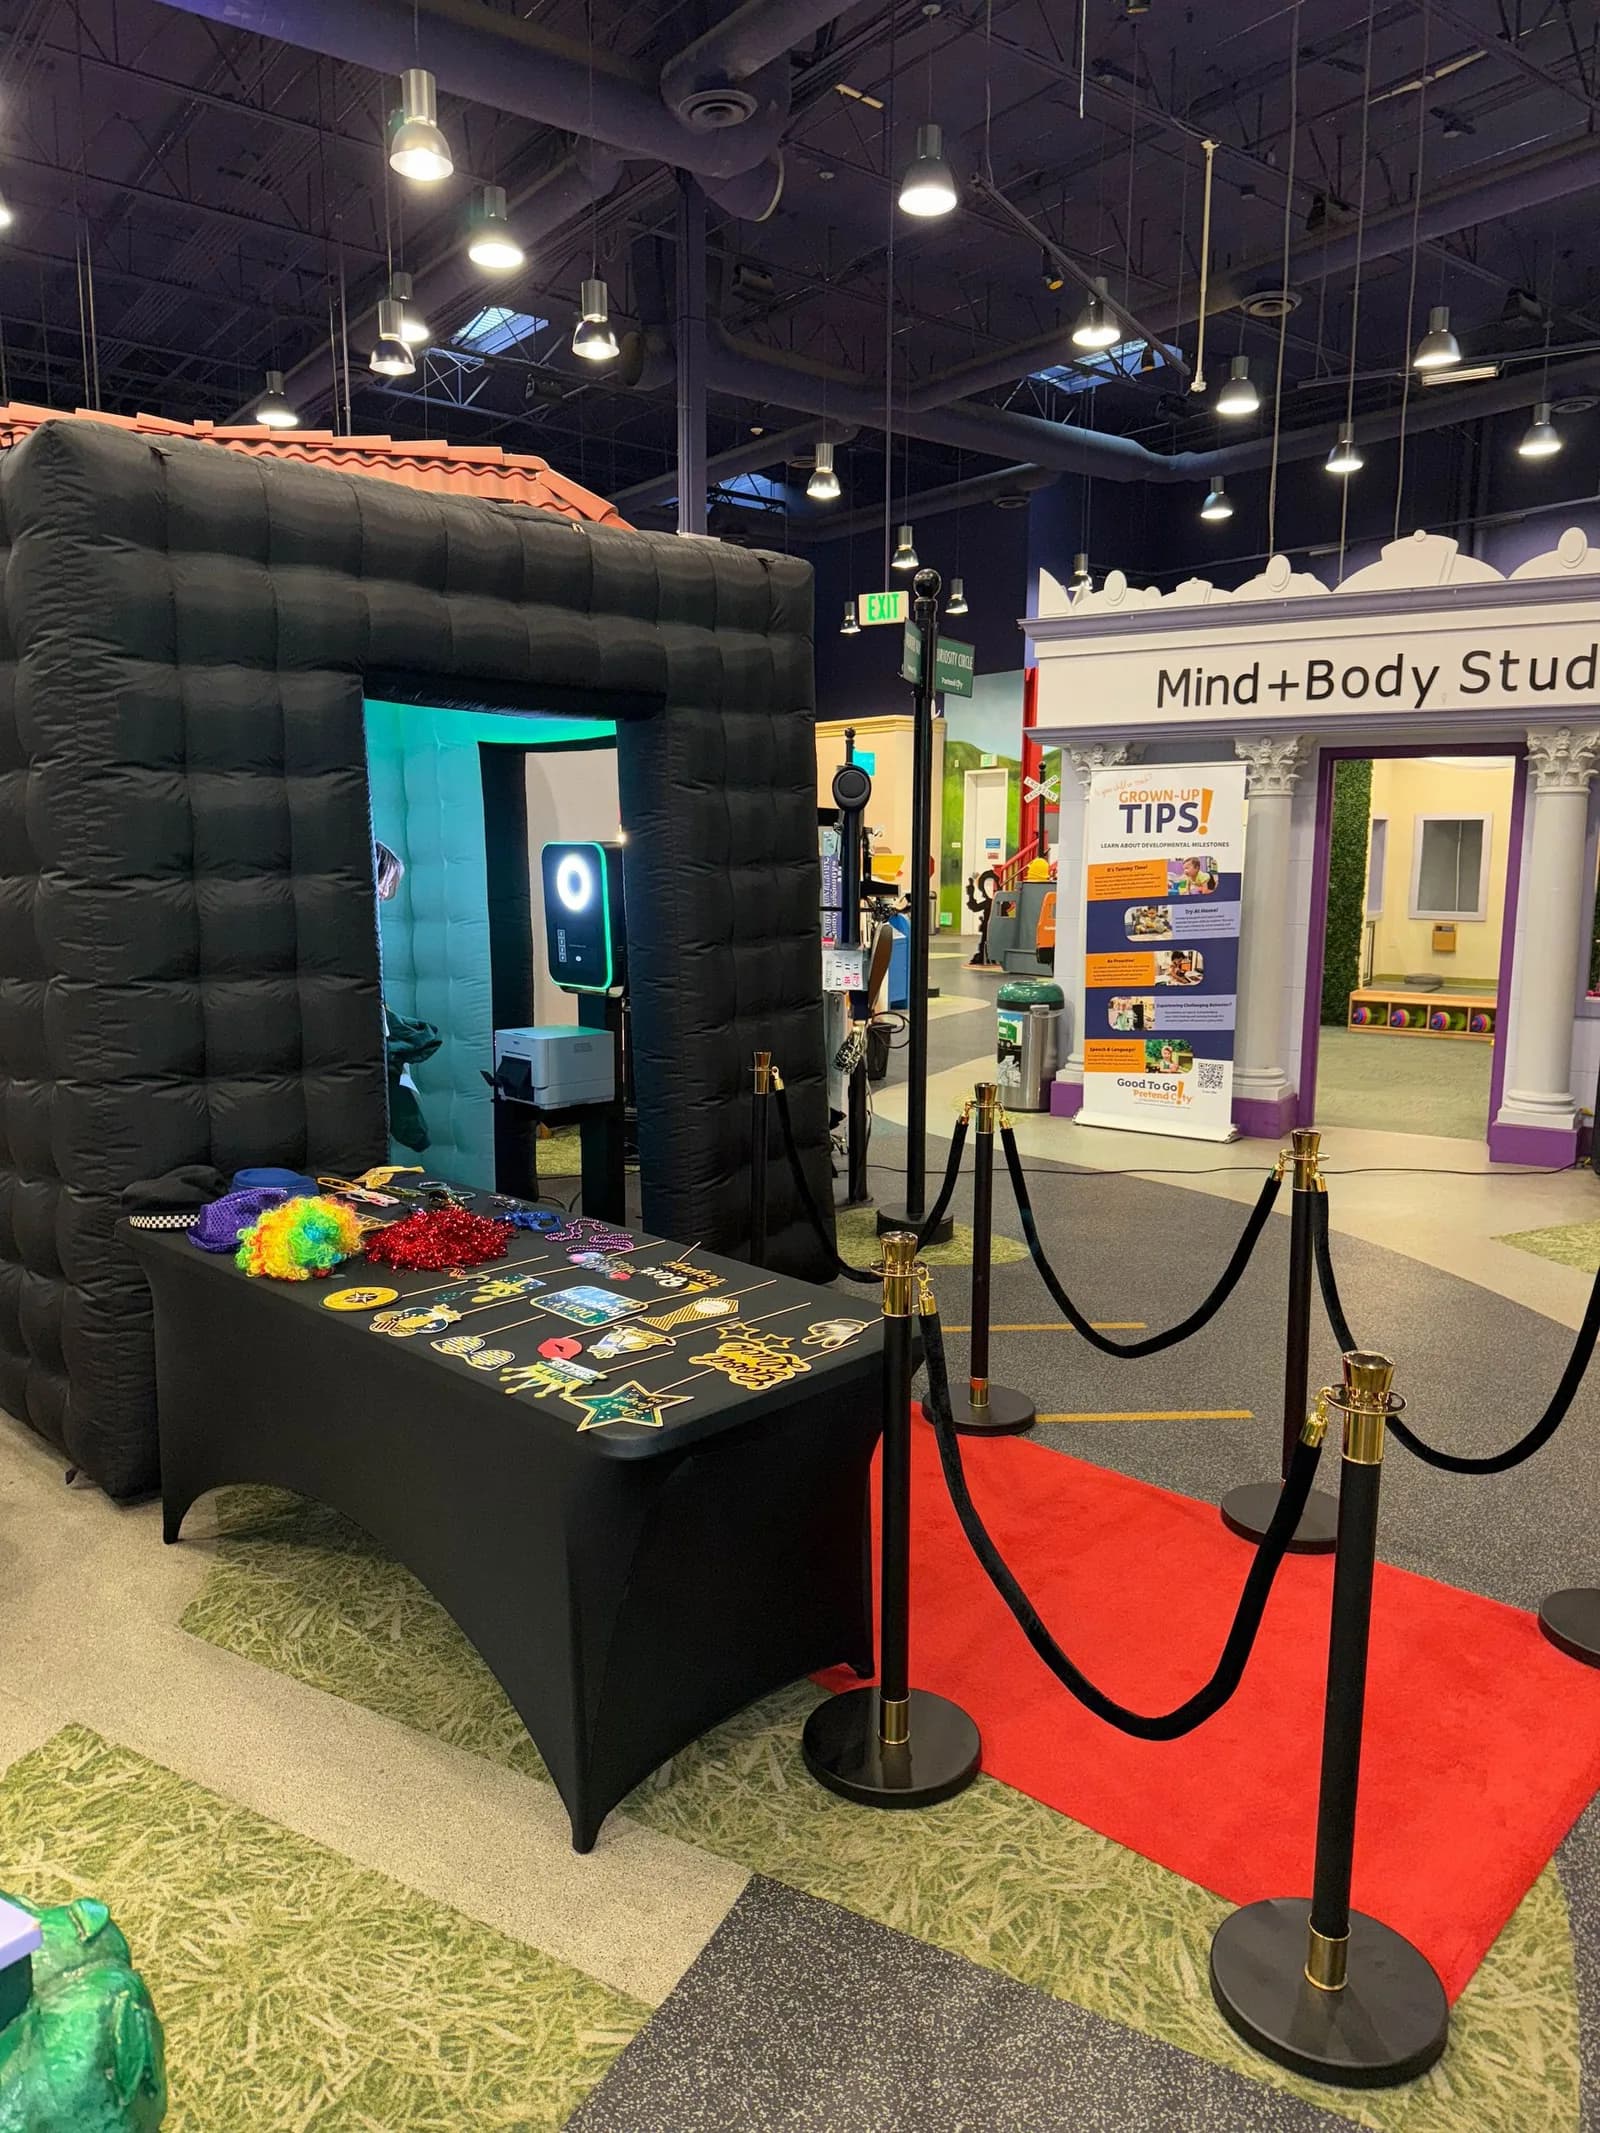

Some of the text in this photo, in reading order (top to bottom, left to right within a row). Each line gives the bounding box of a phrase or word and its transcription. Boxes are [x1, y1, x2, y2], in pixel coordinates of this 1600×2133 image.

[867, 593, 900, 622] EXIT
[958, 654, 974, 670] CIRCLE
[1156, 653, 1440, 709] Mind+Body
[1119, 789, 1200, 803] GROWN-UP
[1119, 788, 1214, 835] TIPS!
[1141, 841, 1190, 849] DEVELOPMENTAL
[1117, 1078, 1146, 1088] Good
[1147, 1081, 1160, 1090] To
[1133, 1089, 1170, 1100] Pretend
[640, 1267, 689, 1288] Bon
